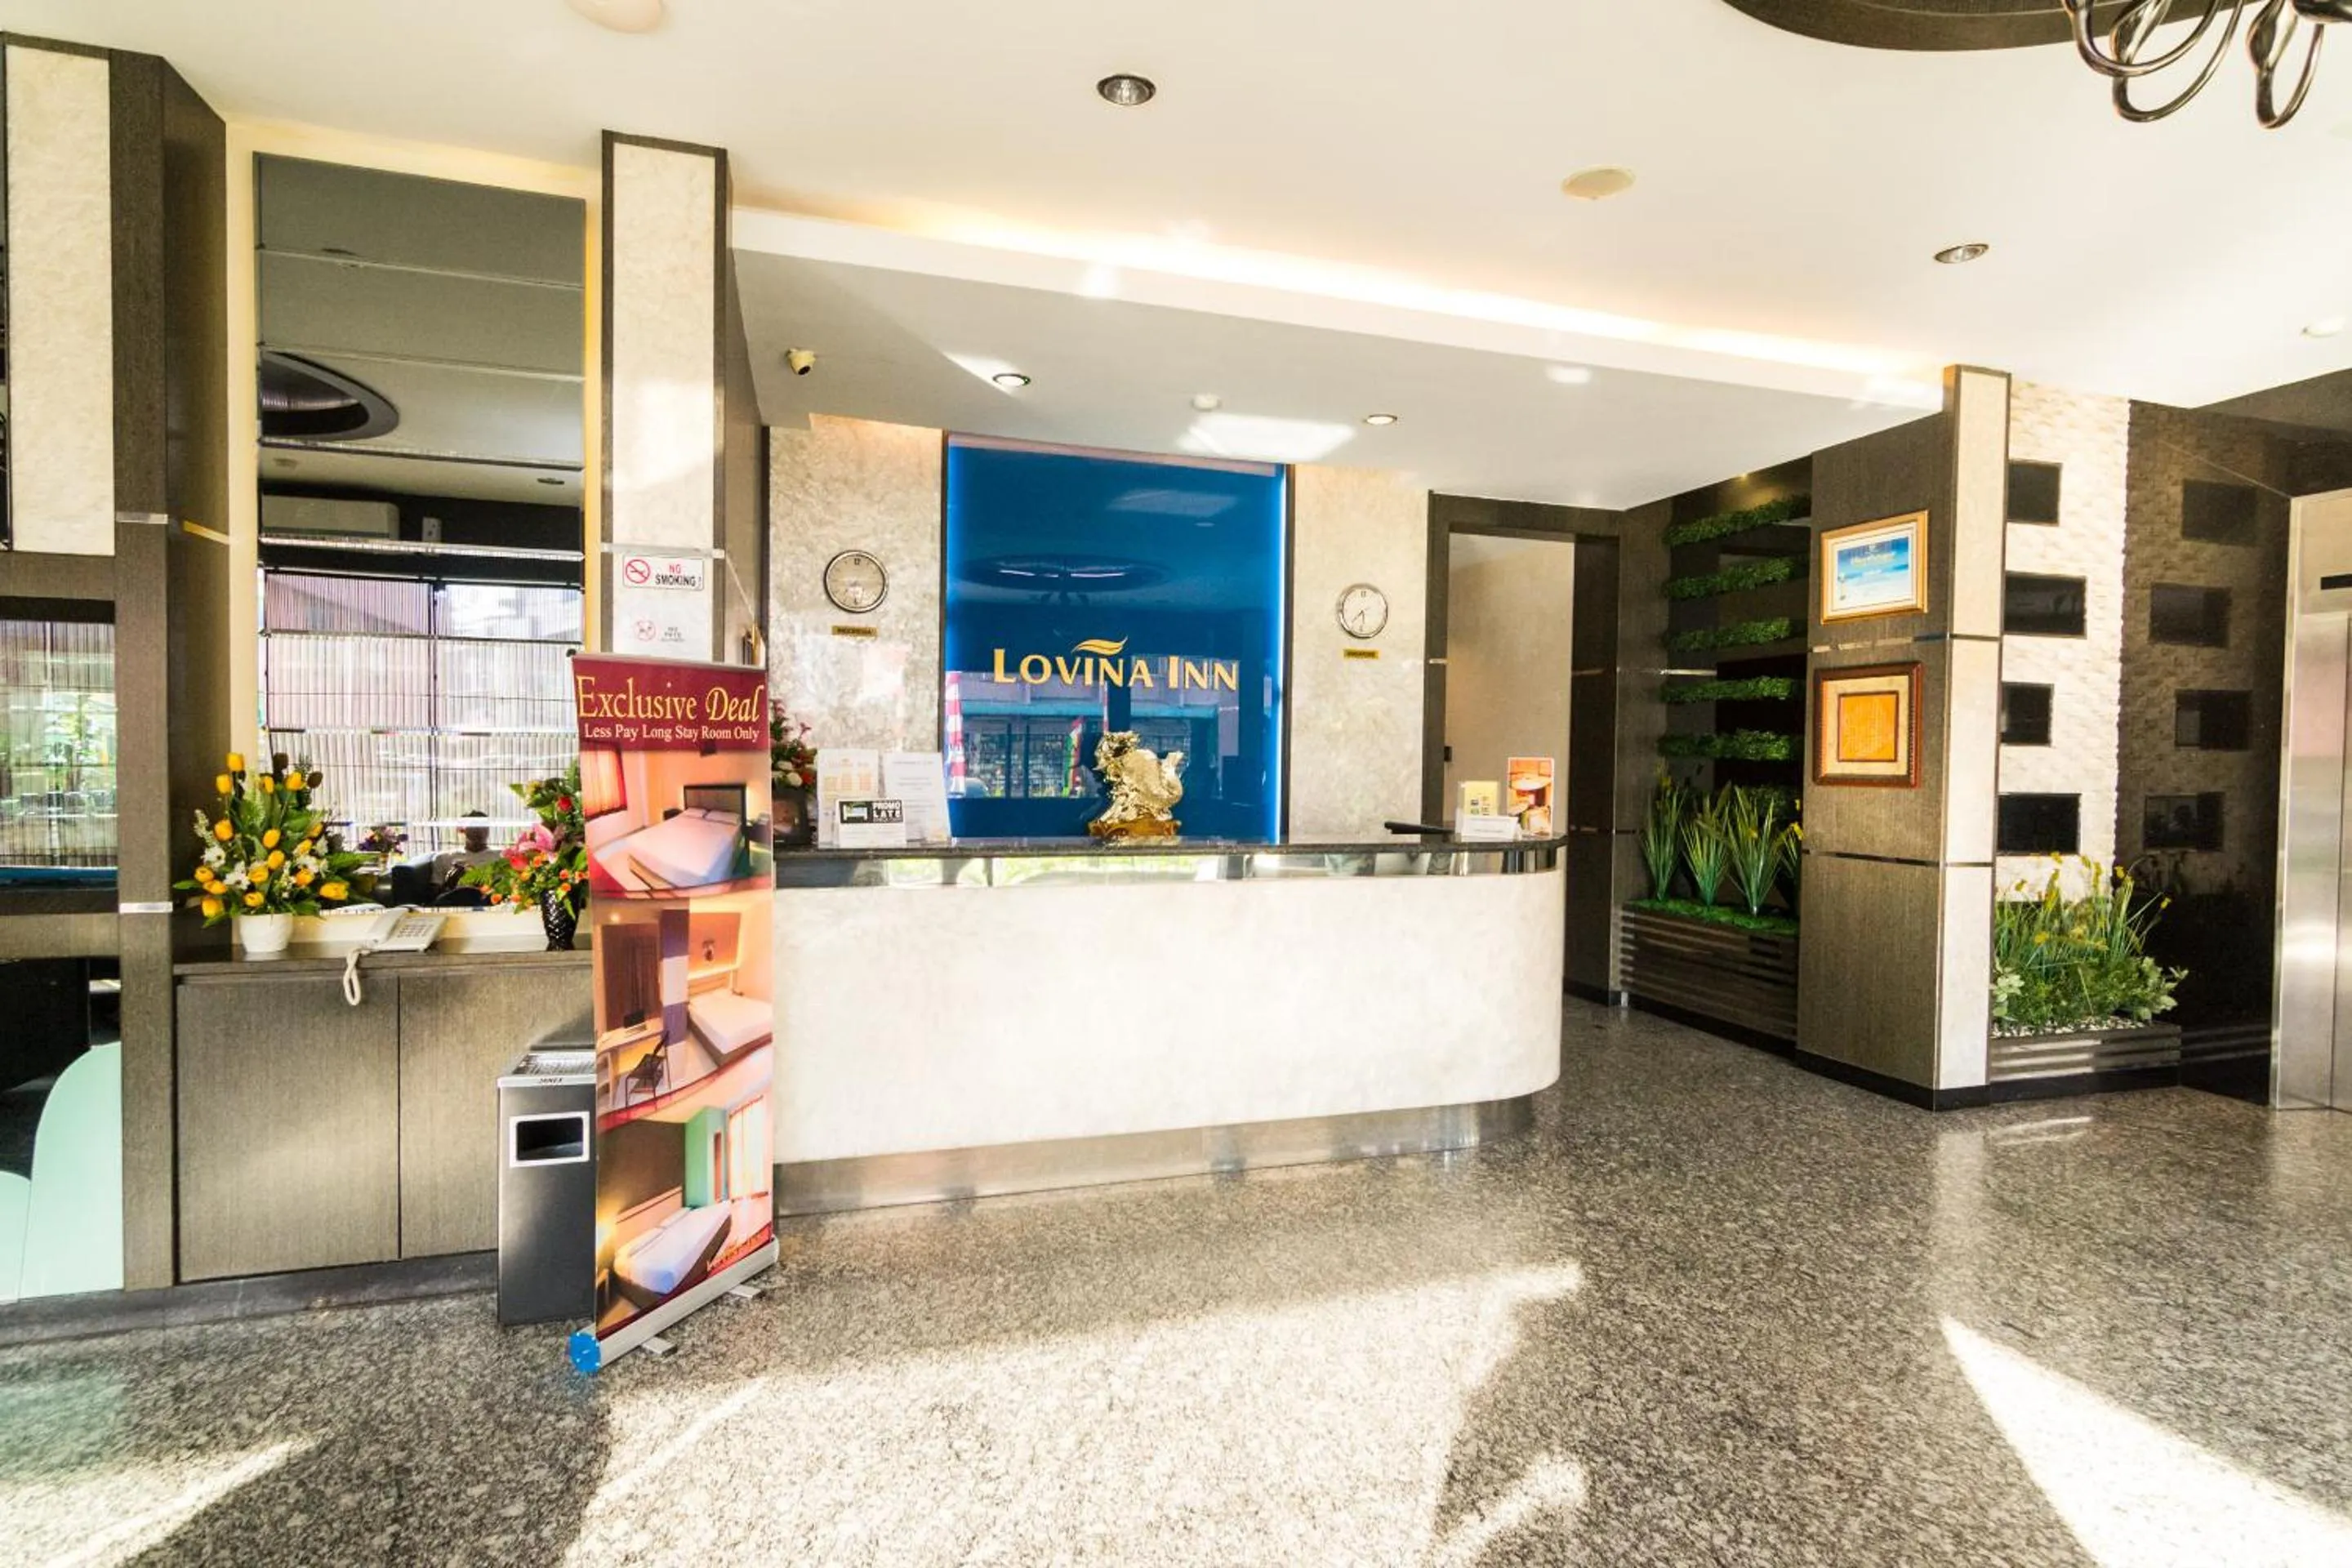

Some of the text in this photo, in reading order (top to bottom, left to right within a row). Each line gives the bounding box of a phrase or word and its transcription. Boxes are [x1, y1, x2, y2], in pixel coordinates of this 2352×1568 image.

[669, 564, 681, 574] NO
[655, 574, 696, 586] SMOKING
[993, 648, 1237, 691] LOVINA INN
[576, 675, 764, 722] Exclusive Deal
[585, 724, 760, 742] Less Pay Long Stay Room Only
